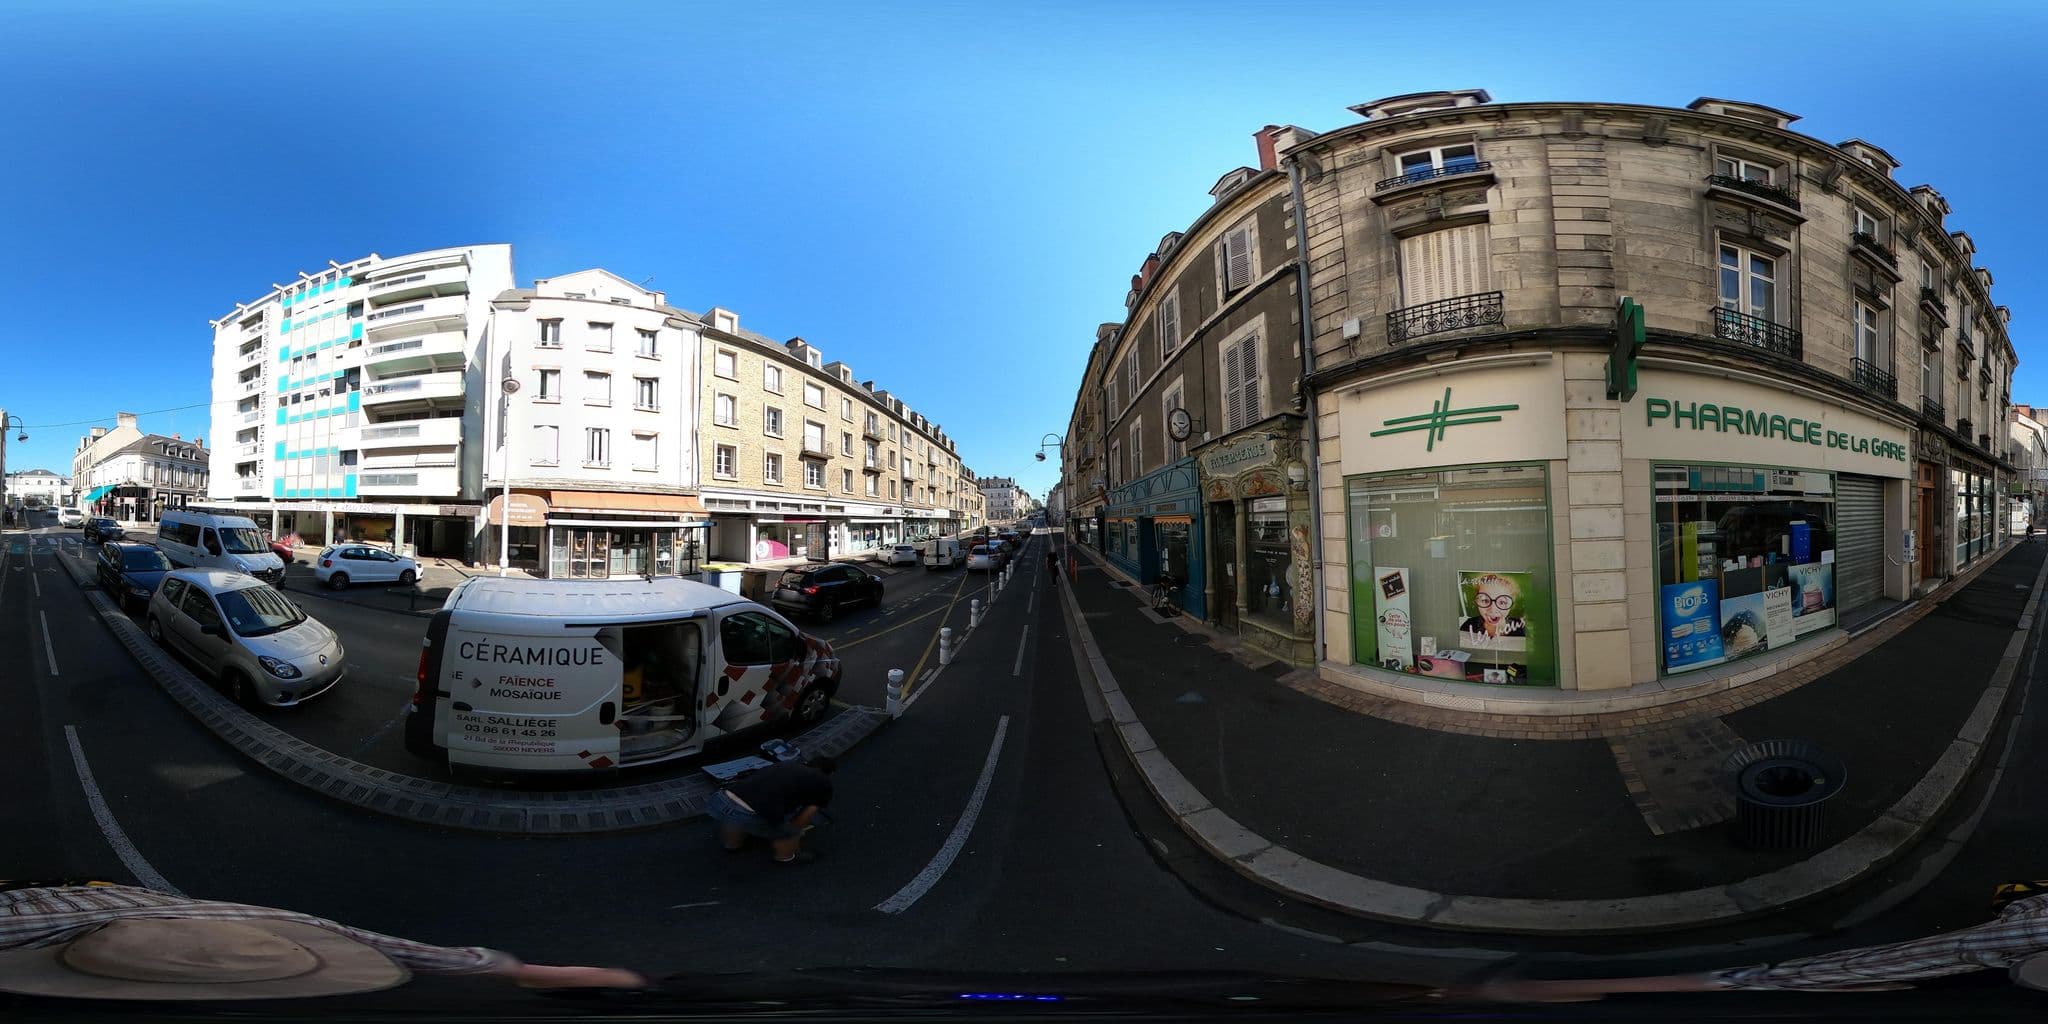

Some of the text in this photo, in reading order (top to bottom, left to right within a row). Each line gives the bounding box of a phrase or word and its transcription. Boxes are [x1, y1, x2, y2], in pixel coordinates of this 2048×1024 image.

[1646, 398, 1906, 462] PHARMACIE DE LA GARE
[1799, 566, 1821, 576] VICHY
[1765, 589, 1789, 599] VICHY
[460, 638, 604, 666] CÉRAMIQUE
[498, 675, 555, 687] FAÏENCE
[490, 688, 562, 700] MOSAÏQUE
[456, 714, 482, 723] SARL
[465, 724, 556, 737] 03 86 61 45 26
